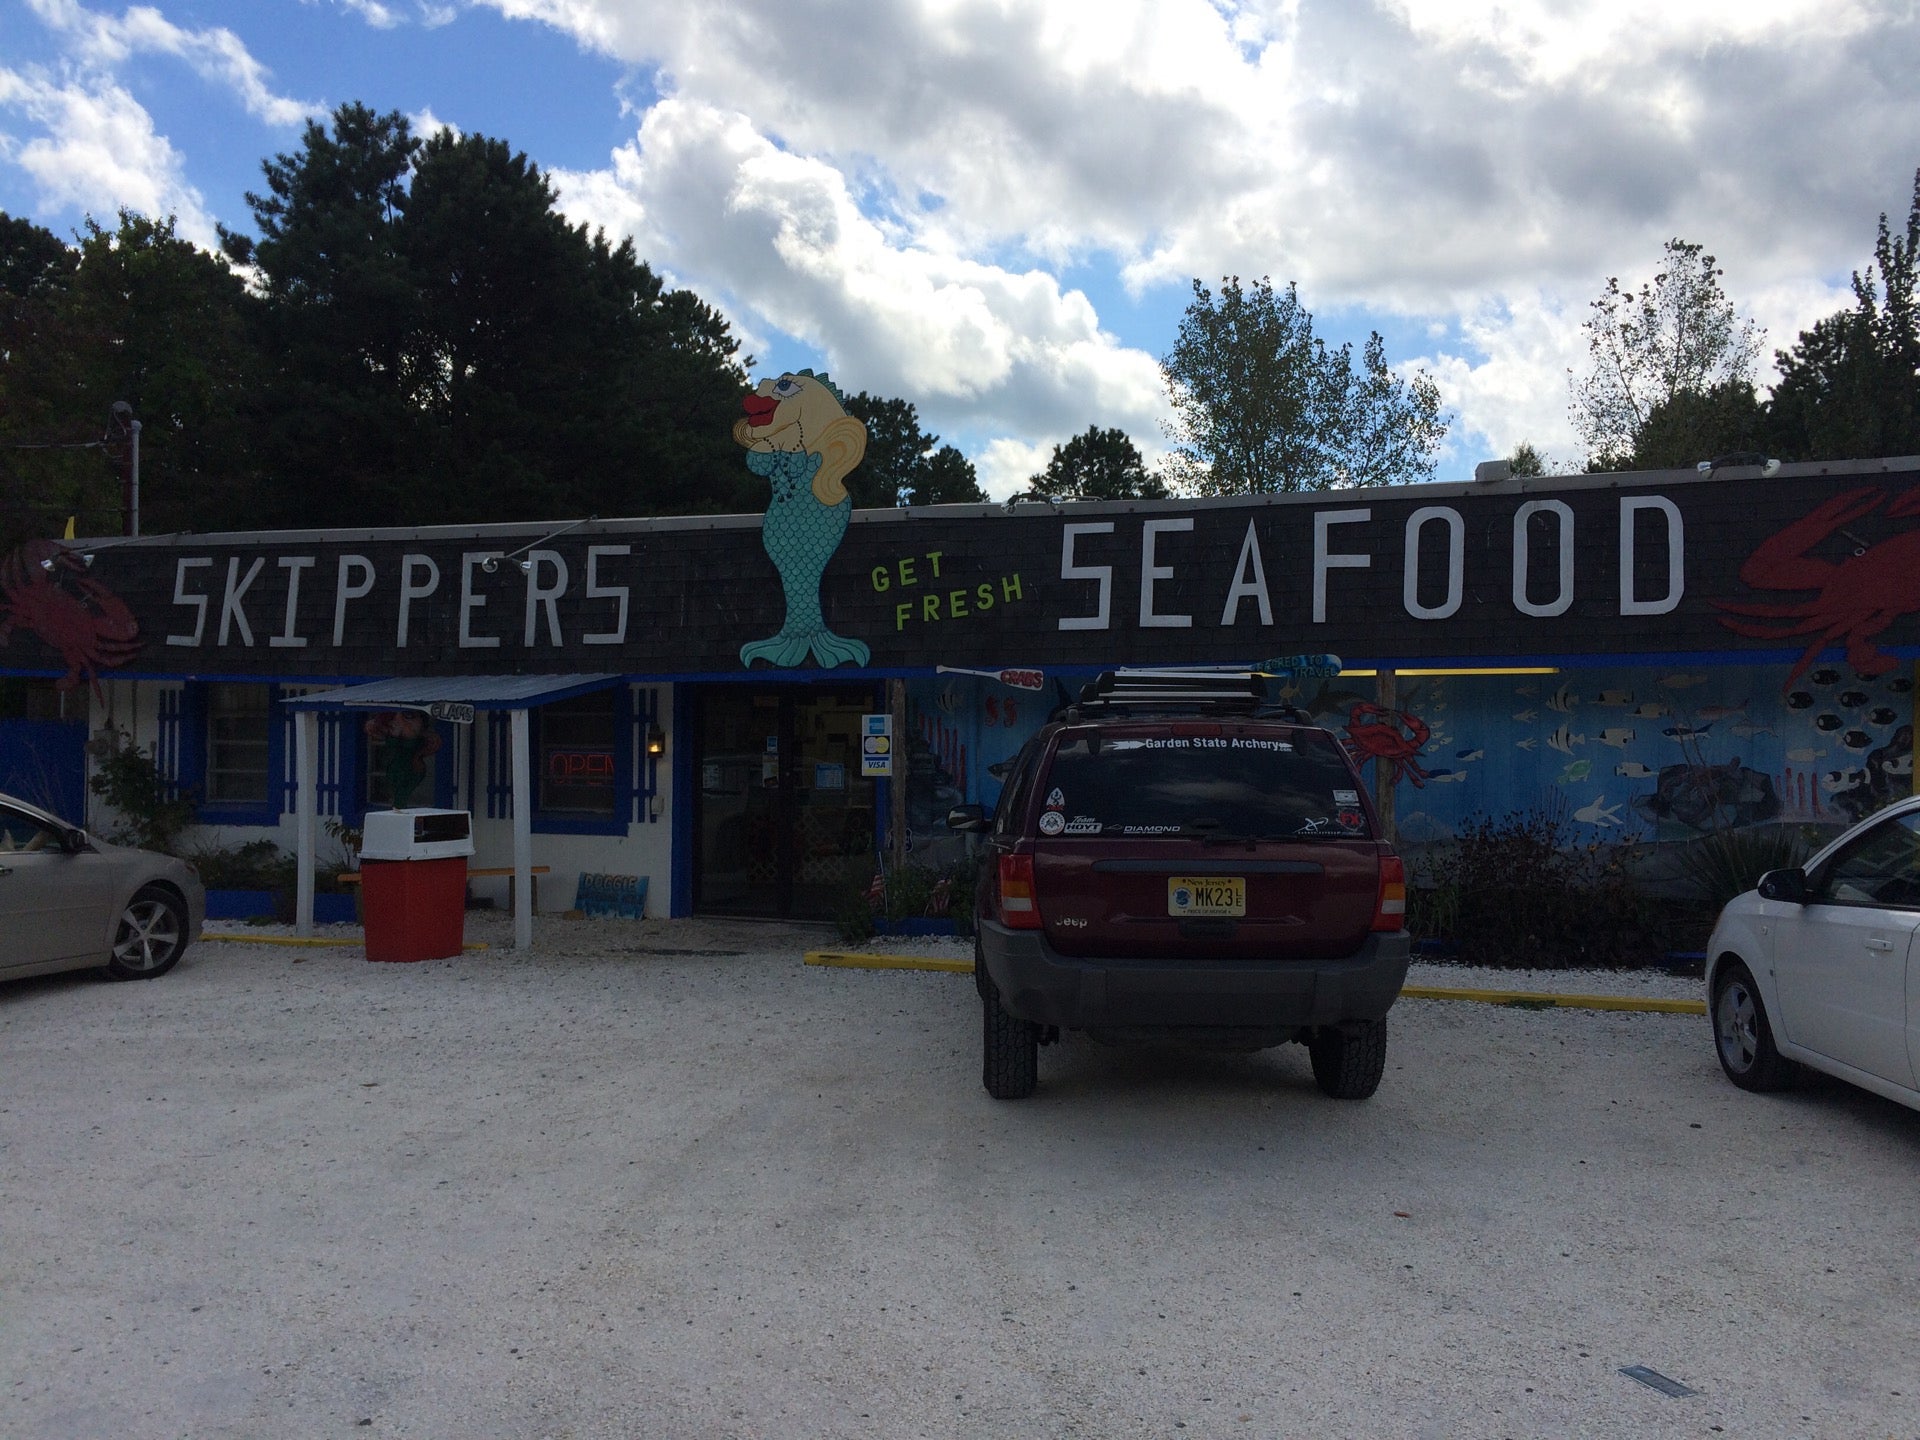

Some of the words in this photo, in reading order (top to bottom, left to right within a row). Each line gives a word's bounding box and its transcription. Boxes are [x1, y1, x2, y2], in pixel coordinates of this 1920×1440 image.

[1058, 495, 1685, 631] SEAFOOD
[870, 551, 945, 594] GET
[164, 546, 632, 648] SKIPPERS
[895, 572, 1024, 632] FRESH
[1001, 670, 1043, 688] CRABS
[431, 702, 474, 721] CLAMS
[1145, 738, 1190, 749] Garden
[1193, 737, 1228, 748] State
[868, 761, 886, 769] VISA
[1073, 815, 1096, 824] Team
[1205, 879, 1226, 887] Jersey
[1195, 887, 1233, 907] MK23
[1056, 915, 1088, 929] Jeep
